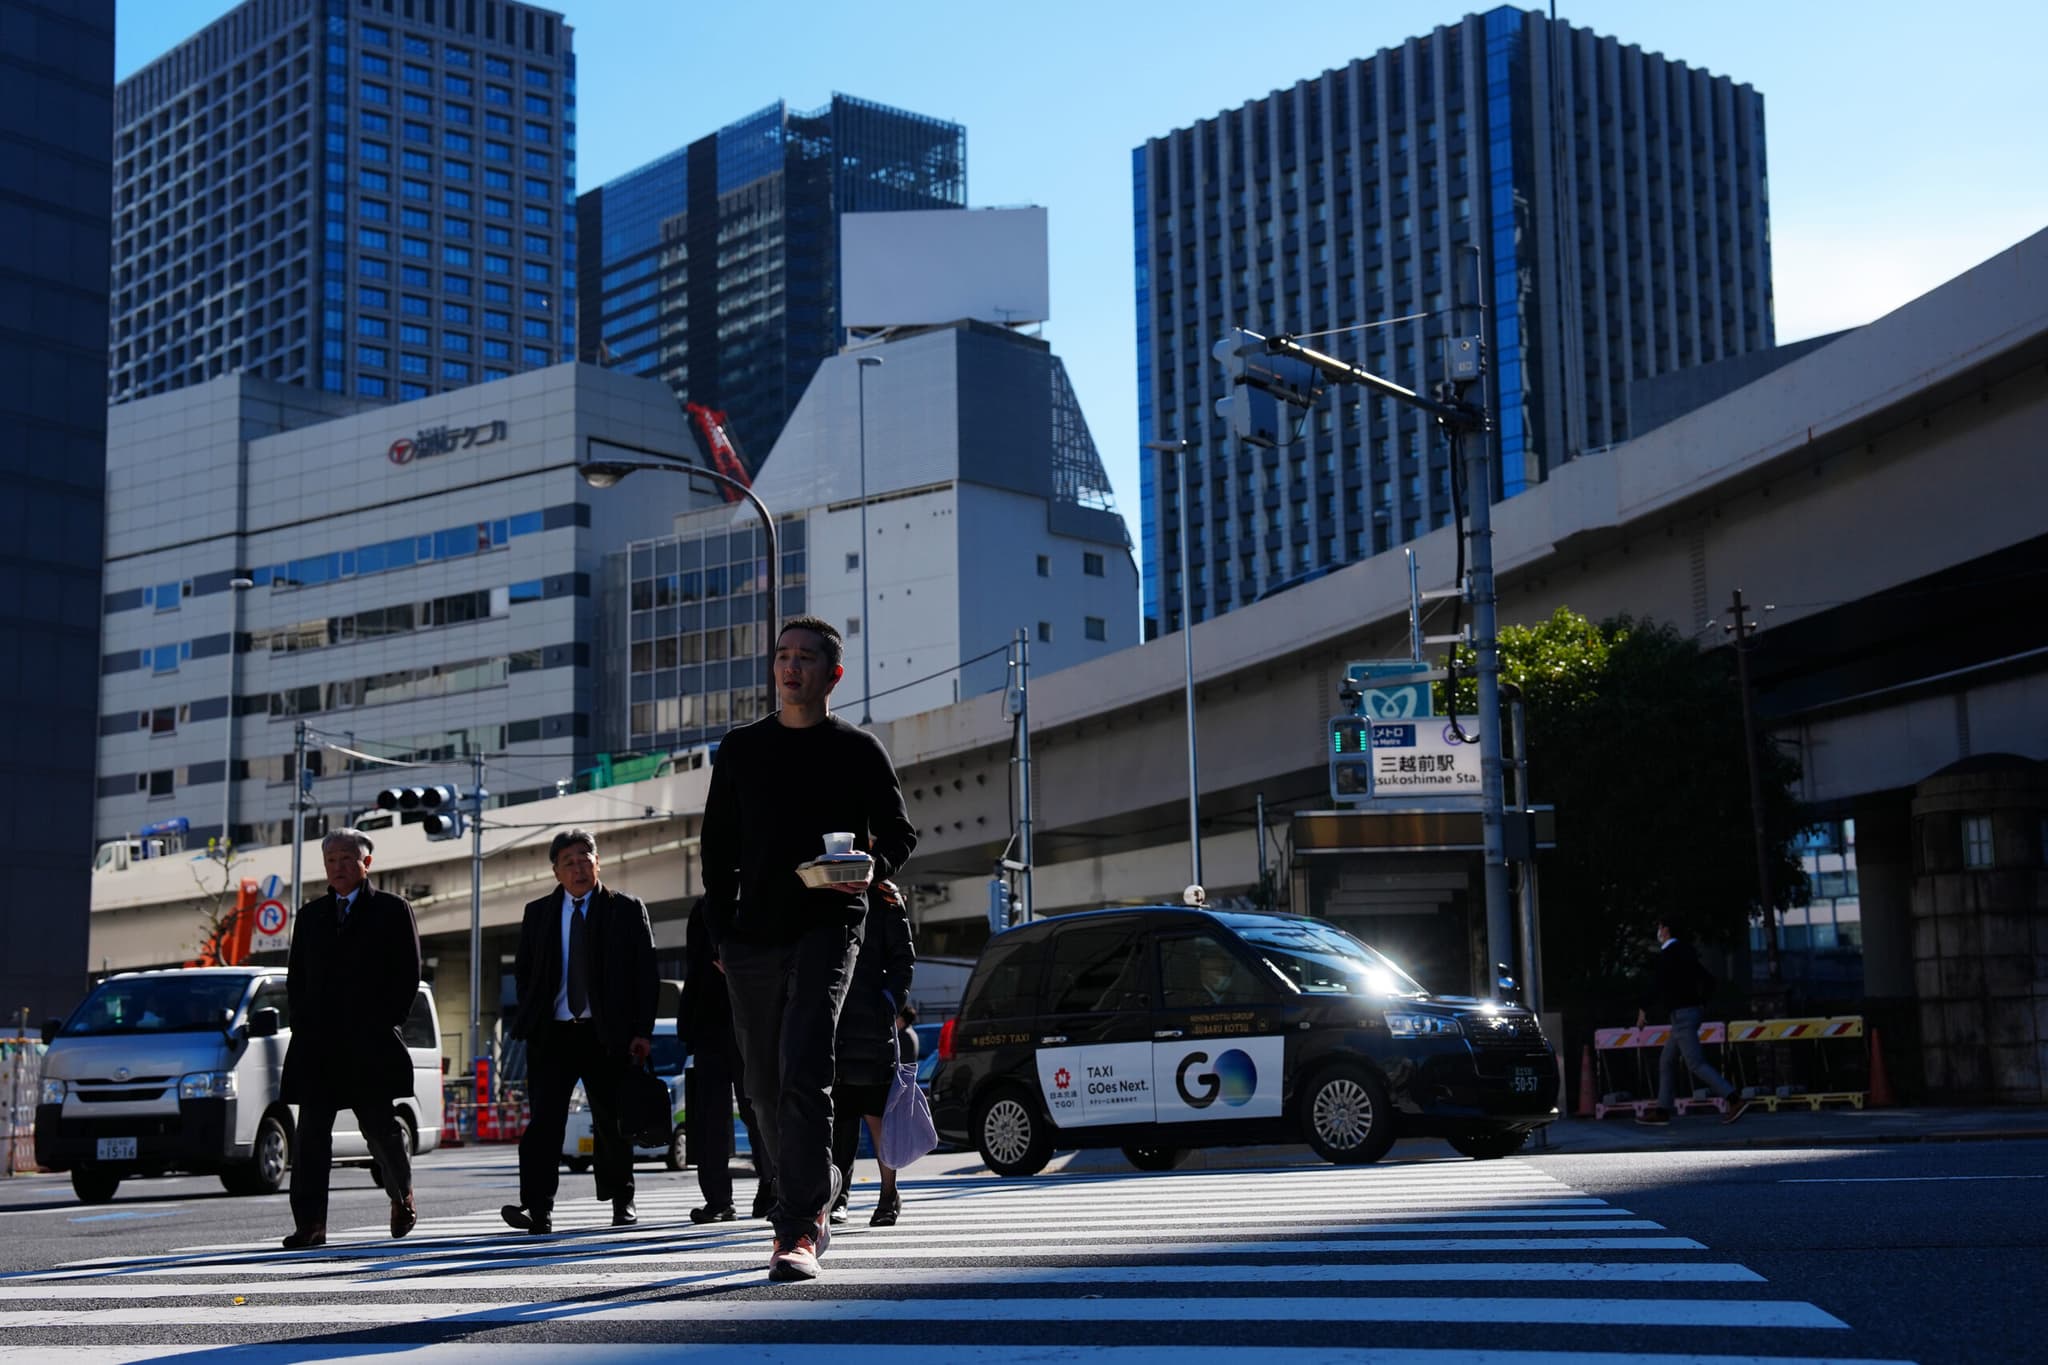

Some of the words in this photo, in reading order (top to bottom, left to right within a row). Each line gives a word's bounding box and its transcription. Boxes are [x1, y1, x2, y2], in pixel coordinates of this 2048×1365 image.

[1380, 754, 1455, 772] 三越前駅
[1376, 774, 1452, 786] sukoshimae
[1456, 772, 1480, 783] Sta.
[1009, 1033, 1031, 1044] TAXI
[1087, 1065, 1113, 1078] TAXI
[1088, 1082, 1118, 1095] GOes
[1119, 1079, 1149, 1093] Next.
[1514, 1076, 1538, 1092] 50-57
